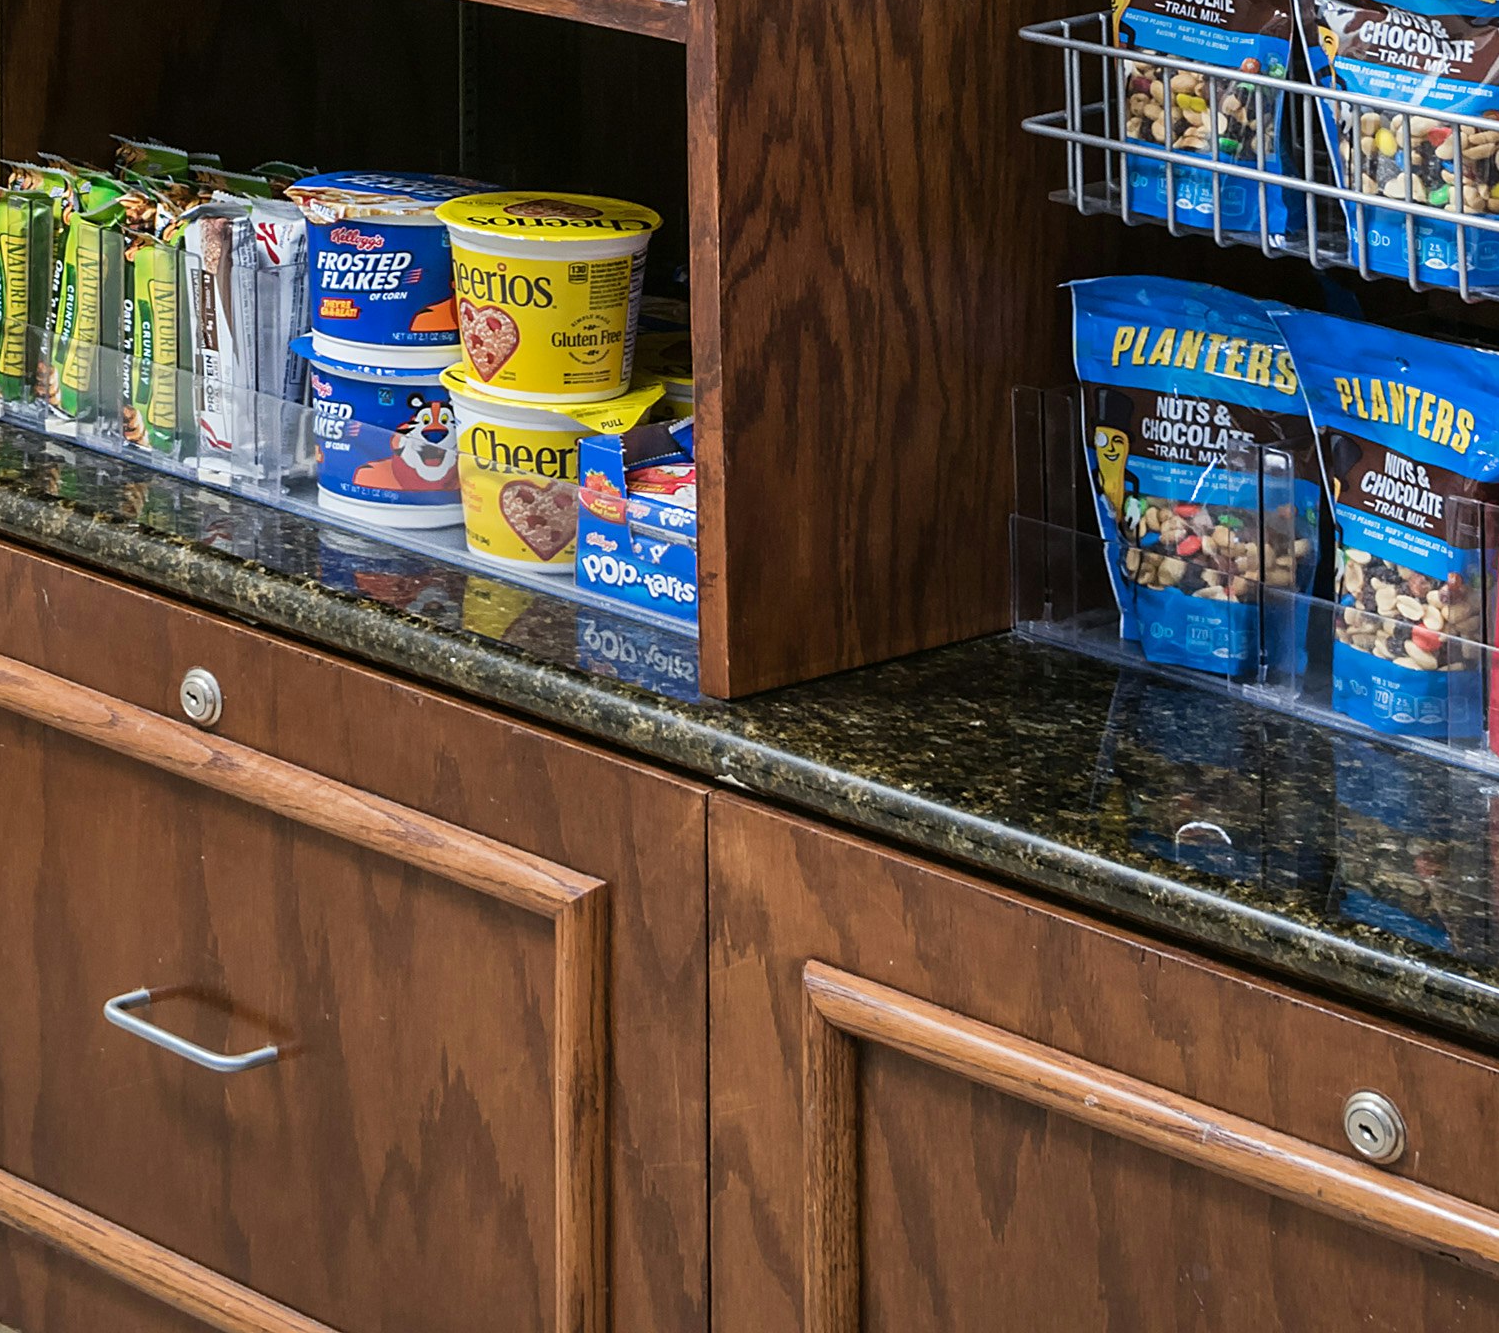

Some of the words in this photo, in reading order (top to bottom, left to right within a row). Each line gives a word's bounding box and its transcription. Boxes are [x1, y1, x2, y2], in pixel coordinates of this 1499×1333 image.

[1165, 1, 1198, 21] TRAIL
[1200, 10, 1222, 25] MIX
[1359, 21, 1476, 64] CHOCOLATE
[467, 215, 653, 232] Cheerios
[330, 227, 385, 249] Kellogg's
[317, 250, 413, 272] FROSTED
[571, 265, 587, 275] 130
[320, 270, 403, 291] FLAKES
[369, 292, 382, 301] OF
[382, 291, 408, 301] CORN
[61, 284, 75, 344] CRUNCHY
[551, 331, 598, 349] Gluten
[600, 329, 622, 346] Free
[140, 321, 151, 385] CRUNCHY
[1111, 325, 1298, 396] PLANTERS
[1156, 395, 1210, 424] NUTS
[1213, 405, 1232, 427] &
[1334, 377, 1475, 455] PLANTERS
[600, 418, 624, 430] PULL
[1142, 417, 1255, 454] CHOCOLATE
[325, 441, 333, 450] OF
[333, 441, 351, 452] CORN
[1384, 451, 1416, 485] NUTS
[1416, 465, 1432, 489] &
[1360, 470, 1444, 520] CHOCOLATE
